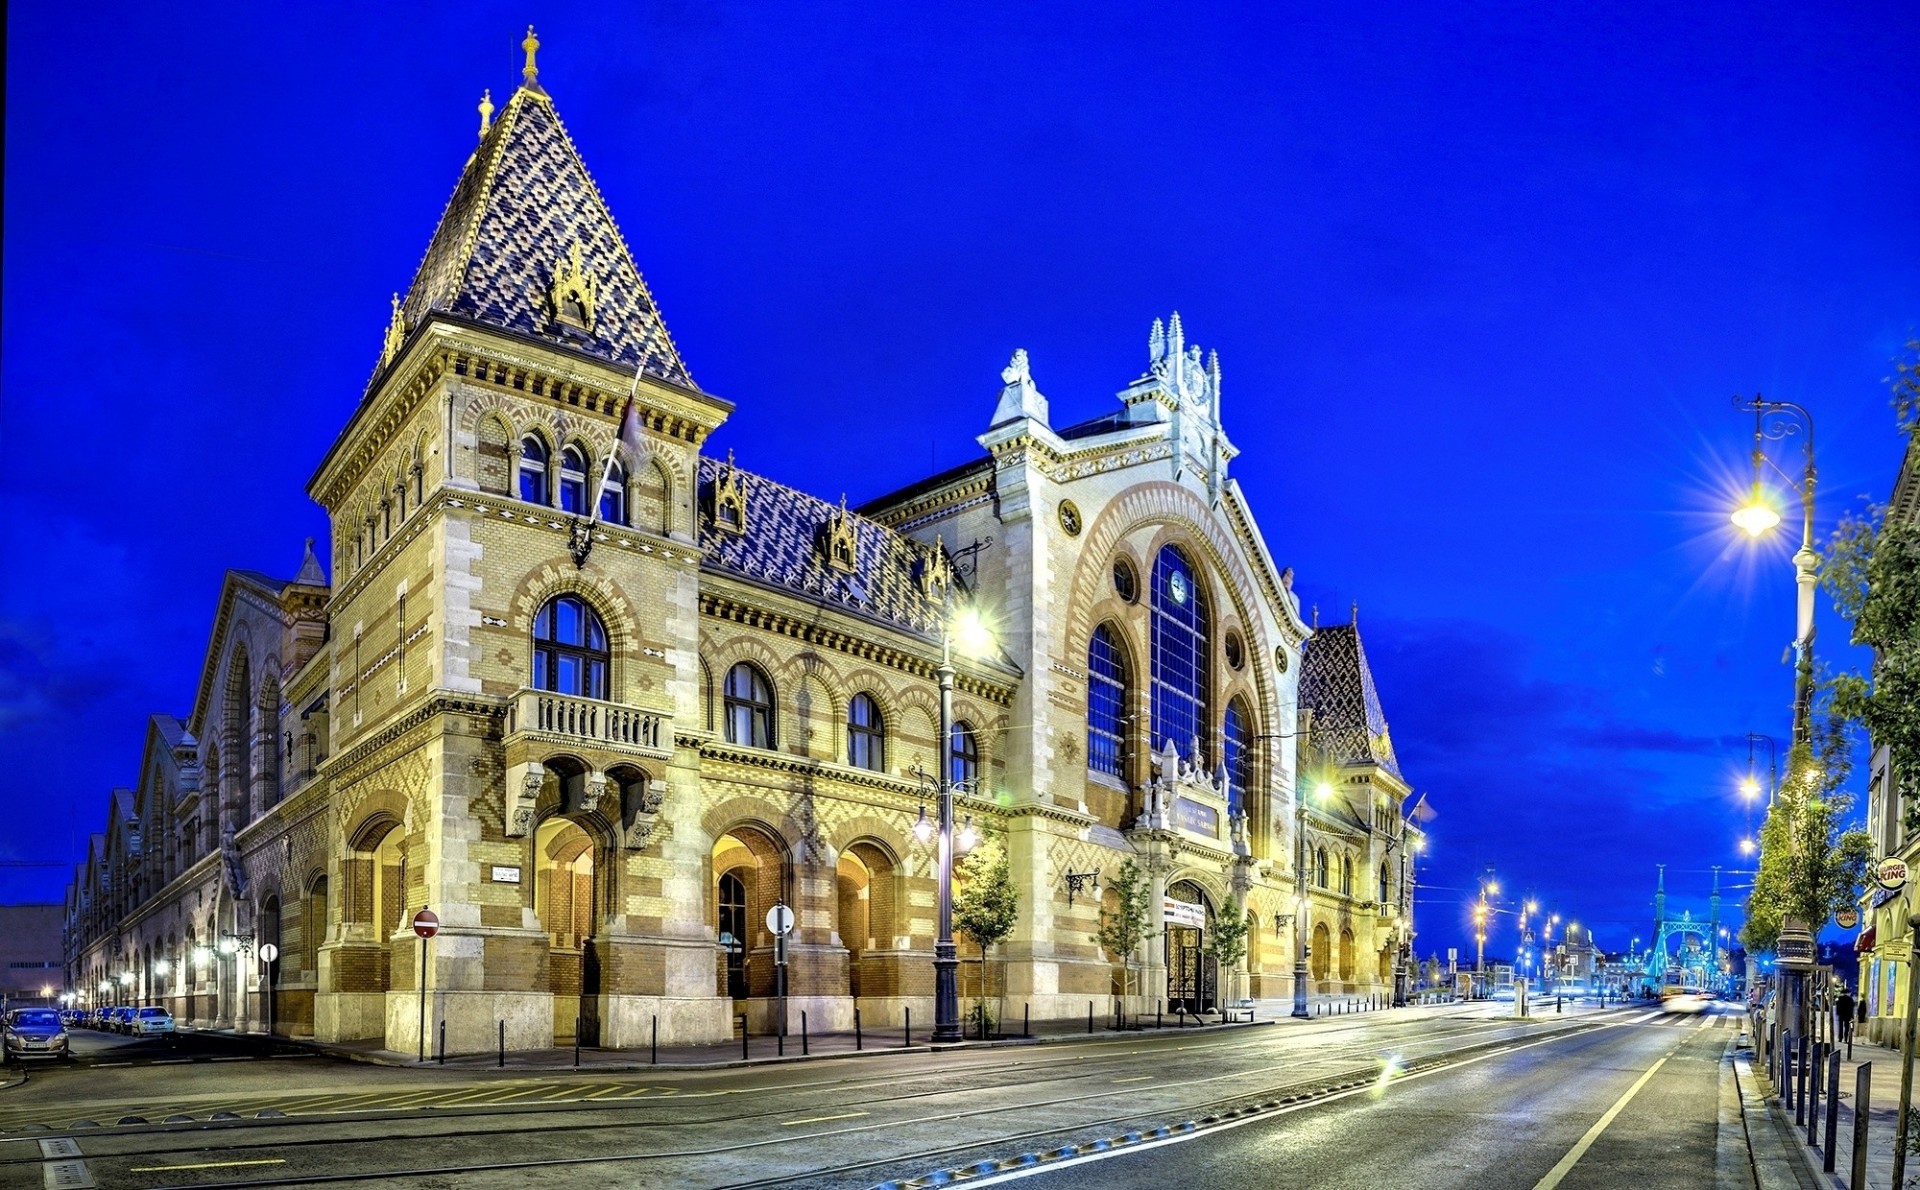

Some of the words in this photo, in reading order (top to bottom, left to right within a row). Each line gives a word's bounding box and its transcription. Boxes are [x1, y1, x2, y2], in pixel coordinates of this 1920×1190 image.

[1880, 864, 1905, 873] BURGER
[1880, 870, 1906, 881] KING
[1839, 912, 1857, 921] KING
